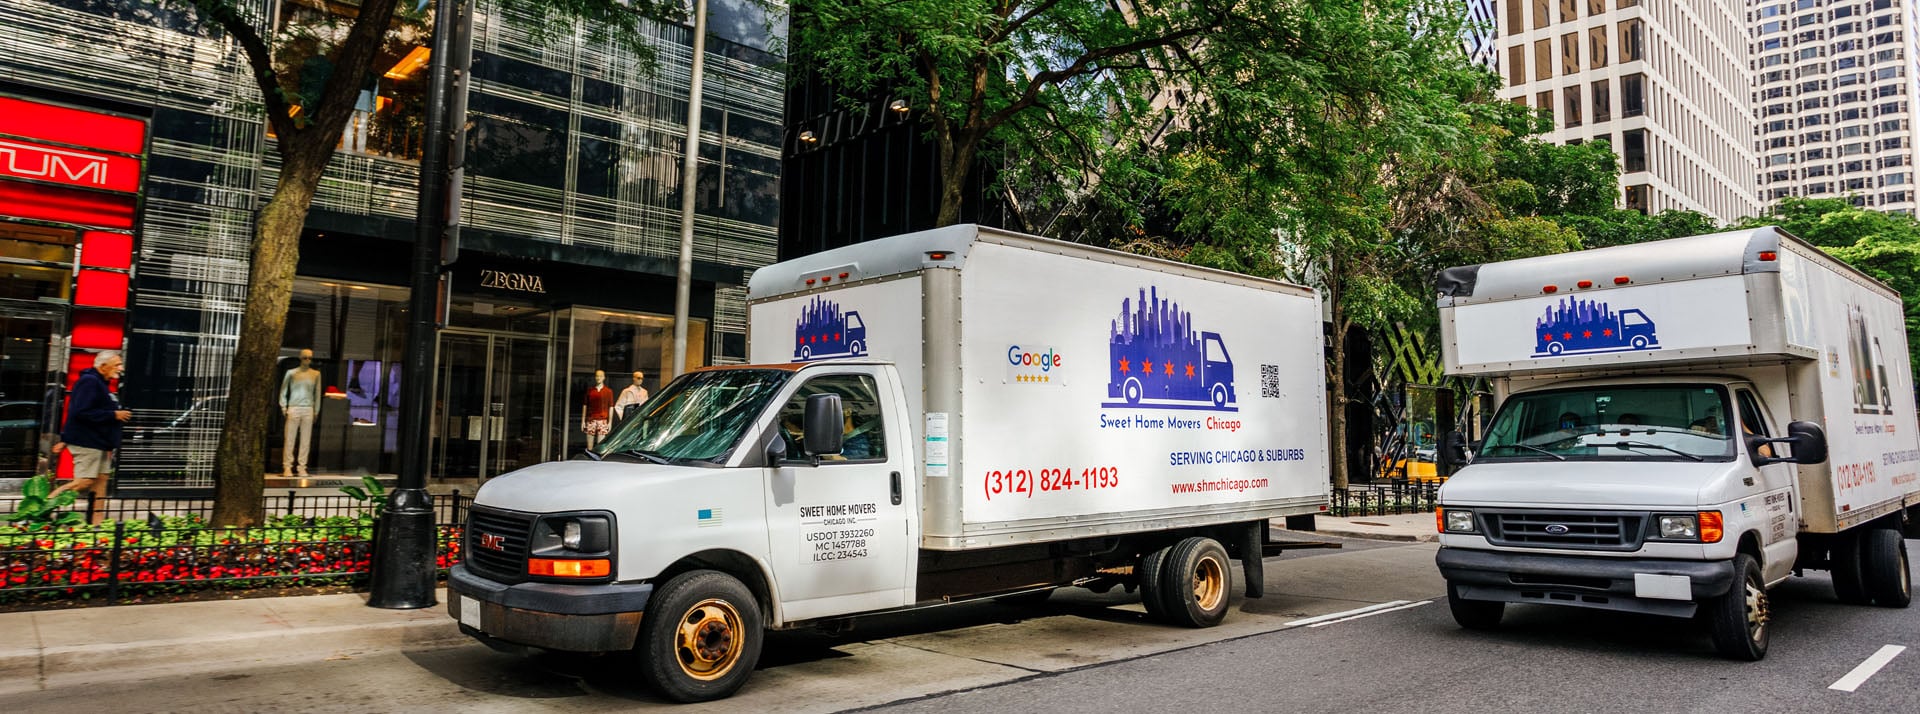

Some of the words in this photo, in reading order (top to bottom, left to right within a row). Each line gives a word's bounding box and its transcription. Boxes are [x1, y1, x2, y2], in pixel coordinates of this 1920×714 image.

[481, 269, 546, 293] ZEGNA
[1008, 345, 1061, 372] Google
[1100, 413, 1131, 429] Sweet
[1135, 414, 1164, 429] Home
[1168, 416, 1201, 430] Movers
[1206, 416, 1241, 432] Chicago
[1170, 451, 1213, 466] SERVING
[1215, 449, 1256, 464] CHICAGO
[1258, 449, 1265, 461] &
[1266, 448, 1305, 462] SUBURBS
[984, 469, 1034, 501] (312)
[1040, 466, 1119, 492] 824-1193
[1171, 477, 1269, 494] www.shmchicago.com
[800, 506, 824, 517] SWEET
[826, 504, 847, 516] HOME
[848, 503, 876, 515] MOVERS
[480, 533, 504, 551] GMC
[806, 532, 837, 541] USDOT
[840, 529, 874, 538] 3932260
[815, 542, 830, 551] MC
[832, 540, 866, 550] 1457788
[813, 552, 836, 561] ILCC:
[837, 549, 867, 559] 234543
